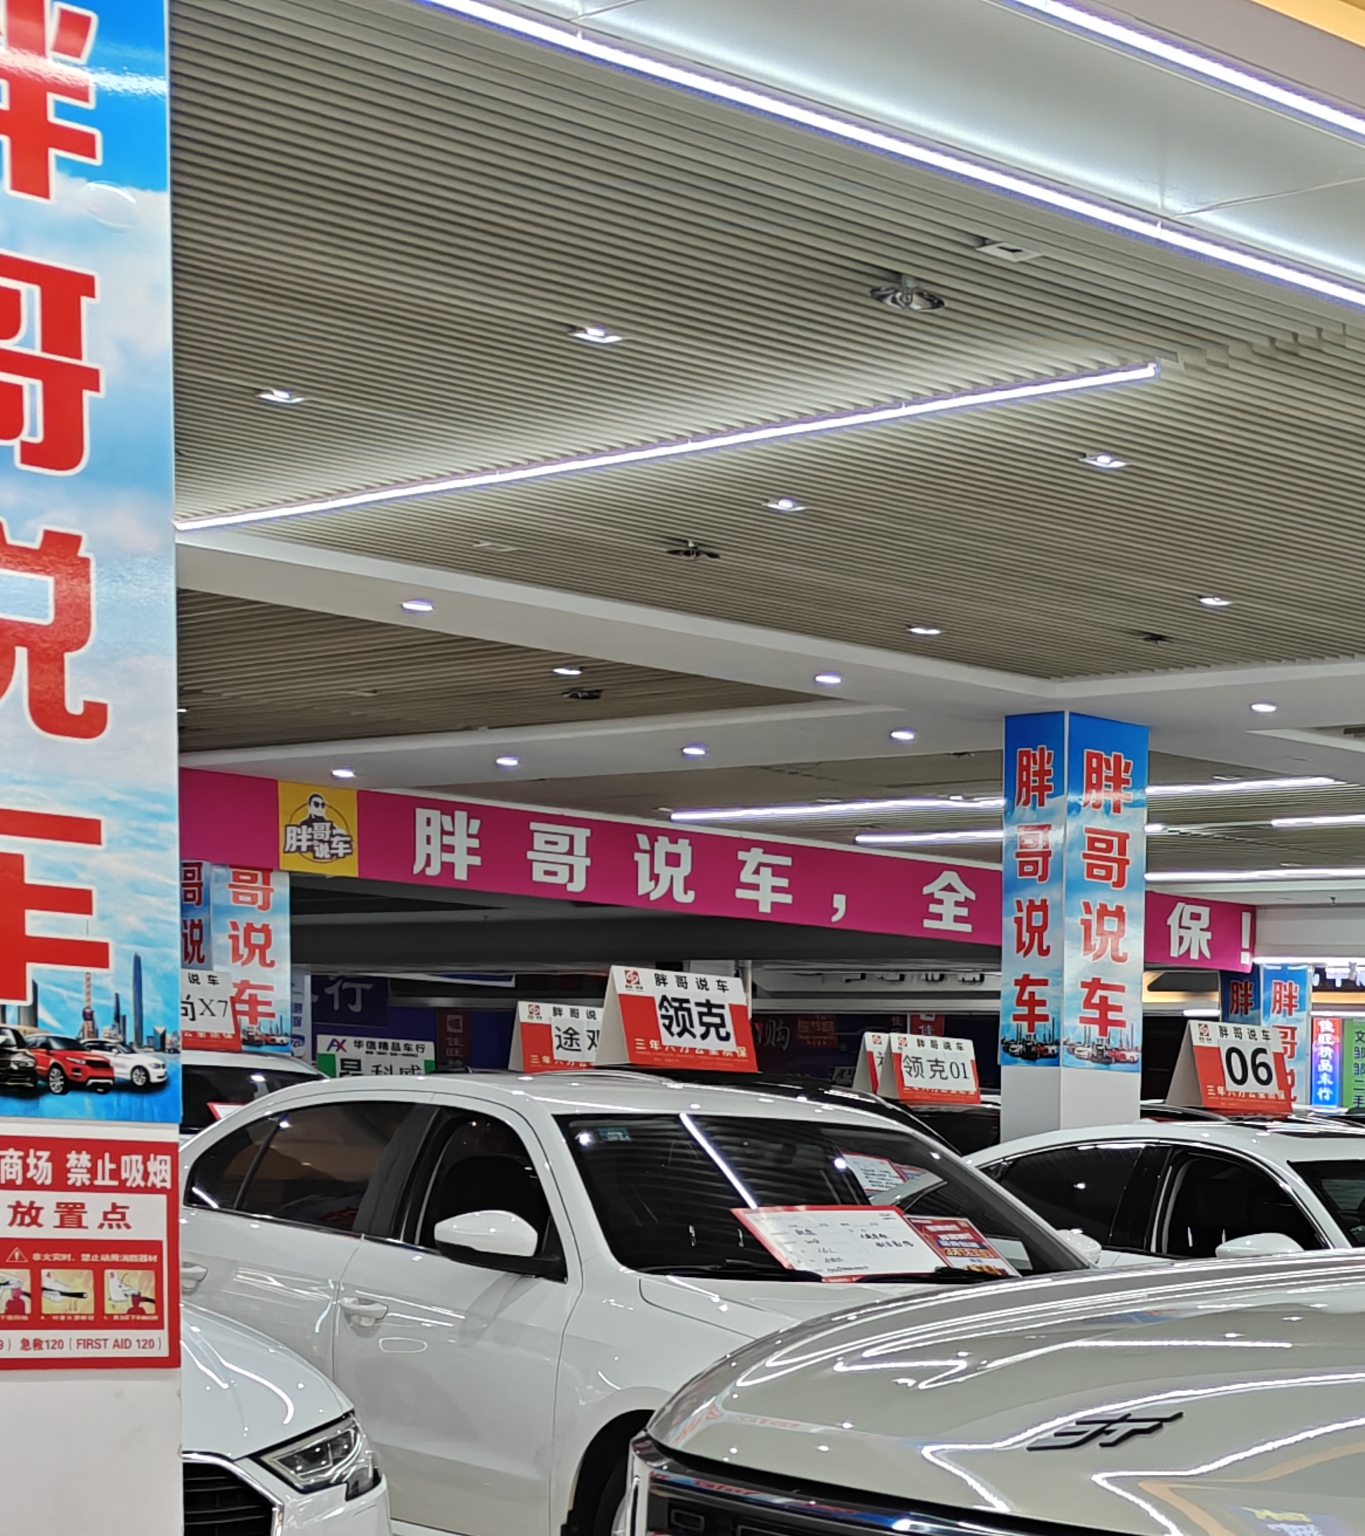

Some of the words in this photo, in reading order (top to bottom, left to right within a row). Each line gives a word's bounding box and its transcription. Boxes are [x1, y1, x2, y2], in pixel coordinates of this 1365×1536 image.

[1013, 745, 1055, 1034] 胖哥说车
[1079, 748, 1134, 1038] 胖哥说车
[653, 972, 731, 993] 胖哥说车
[658, 994, 732, 1042] 领克
[902, 1053, 971, 1081] 领克01
[1225, 1046, 1273, 1087] 06
[65, 1150, 173, 1190] 禁止吸烟
[7, 1200, 133, 1231] 放置点
